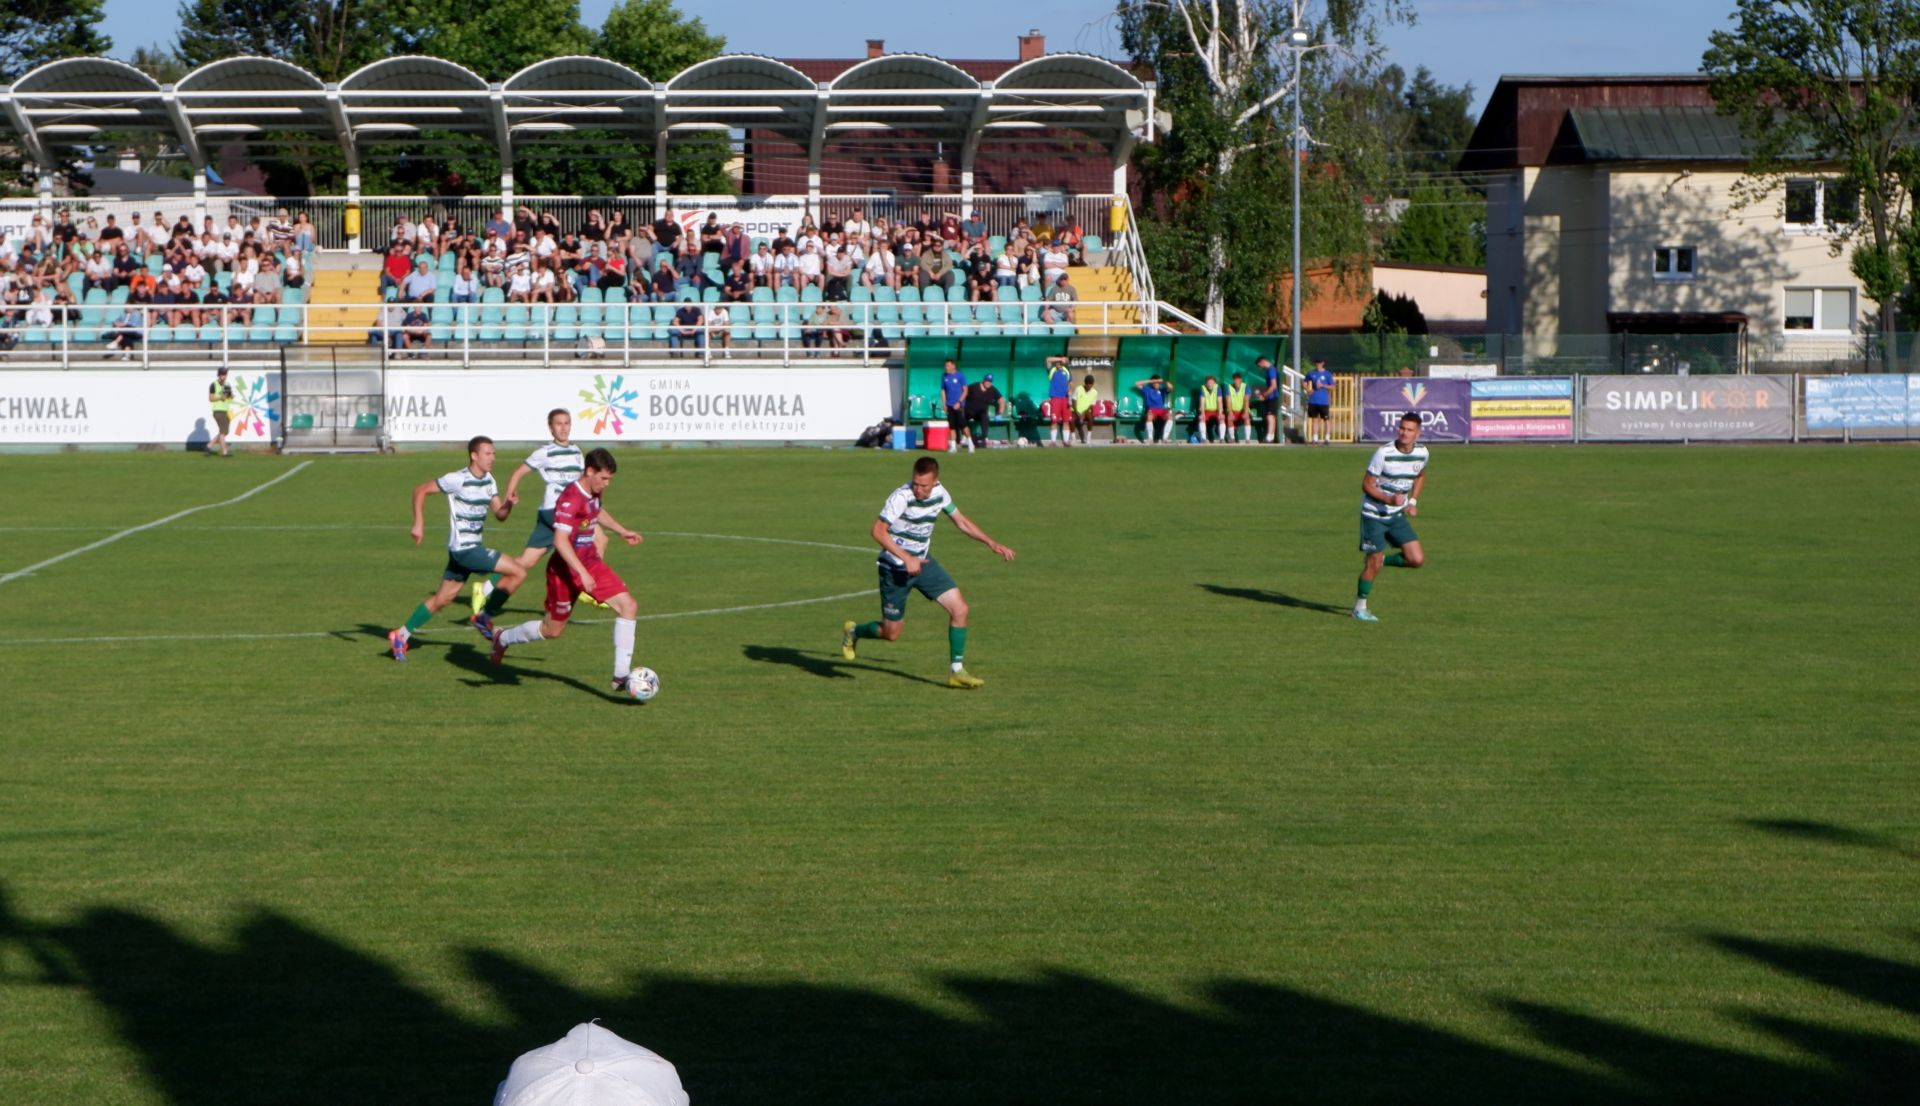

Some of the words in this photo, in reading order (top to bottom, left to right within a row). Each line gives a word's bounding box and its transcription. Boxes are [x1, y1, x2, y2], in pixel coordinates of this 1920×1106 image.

[649, 379, 691, 390] GMINA
[650, 394, 805, 417] BOGUCHWAŁA
[649, 420, 725, 432] pozytywnie
[731, 420, 806, 432] elektryzuje
[1621, 419, 1665, 430] systemy
[1670, 419, 1755, 429] fotowoltaiczne
